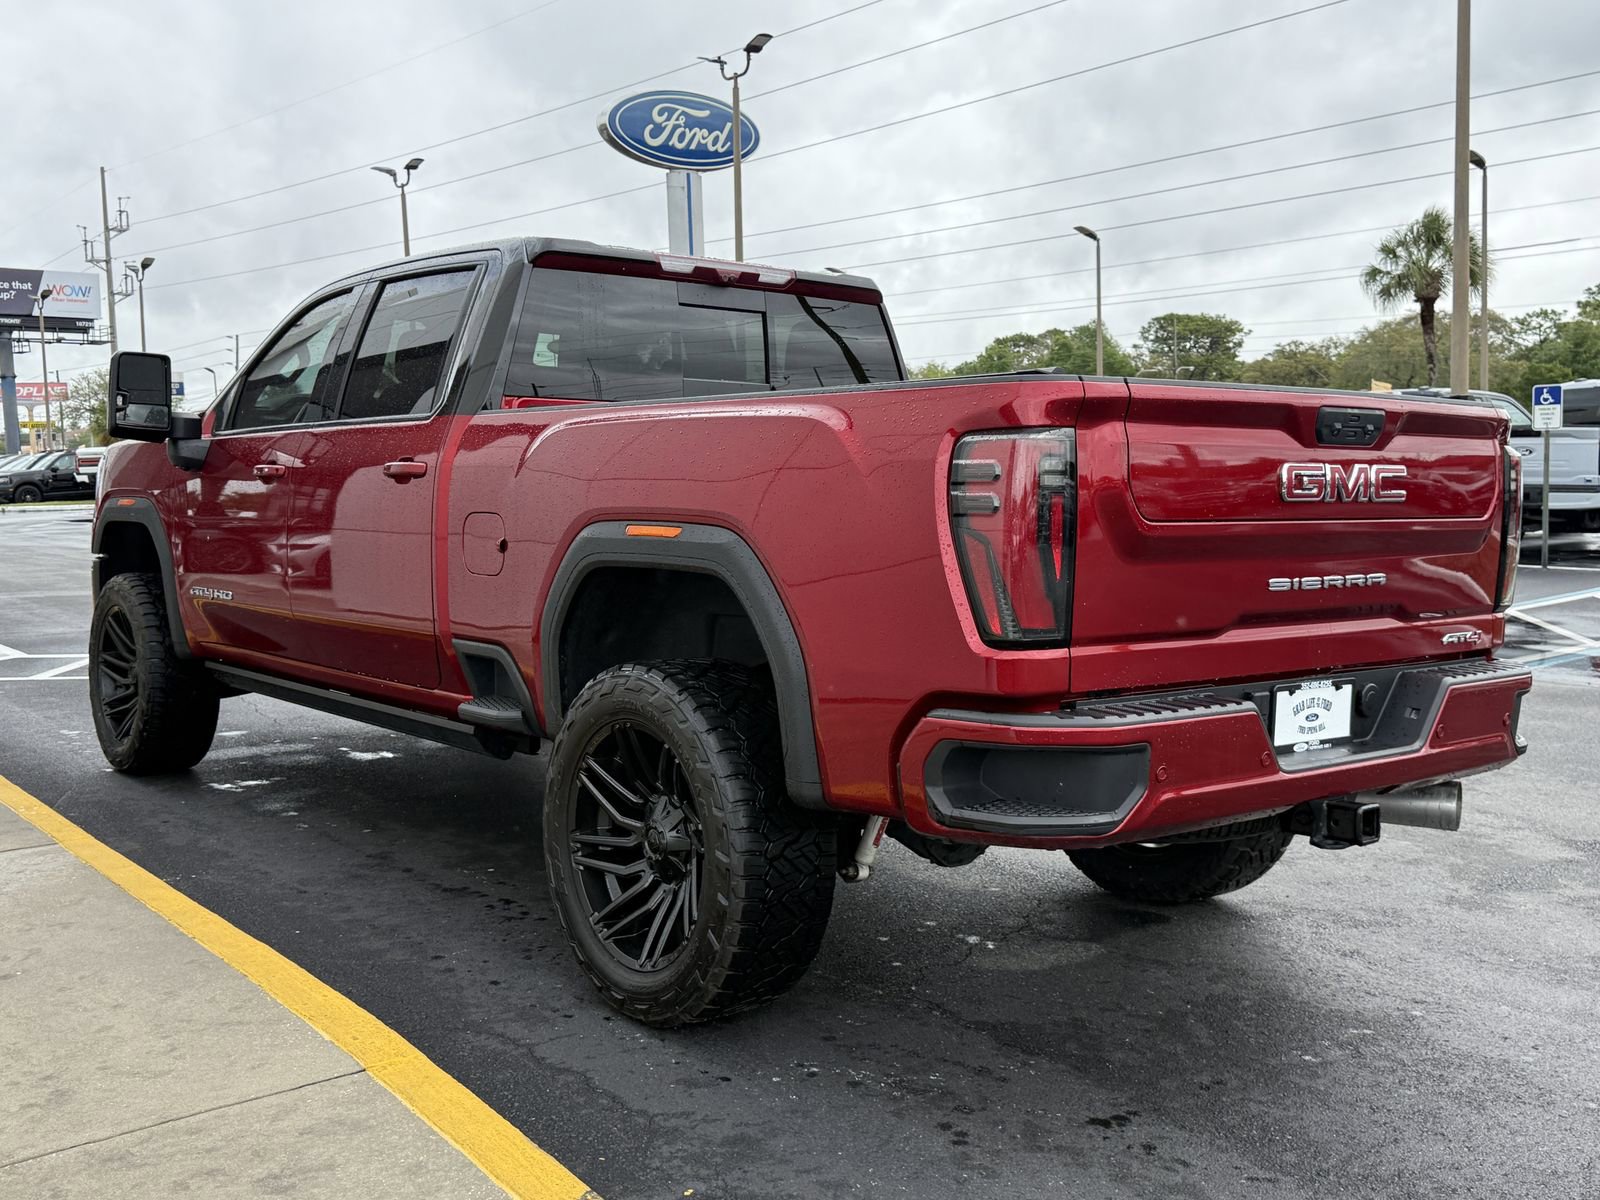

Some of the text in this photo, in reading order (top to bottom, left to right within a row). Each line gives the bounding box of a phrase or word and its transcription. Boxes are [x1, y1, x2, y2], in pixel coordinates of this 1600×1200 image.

[643, 103, 733, 153] Ford
[11, 280, 33, 290] that
[46, 283, 92, 298] WOW!
[1279, 462, 1408, 503] GMC
[1268, 572, 1388, 592] SIERRA
